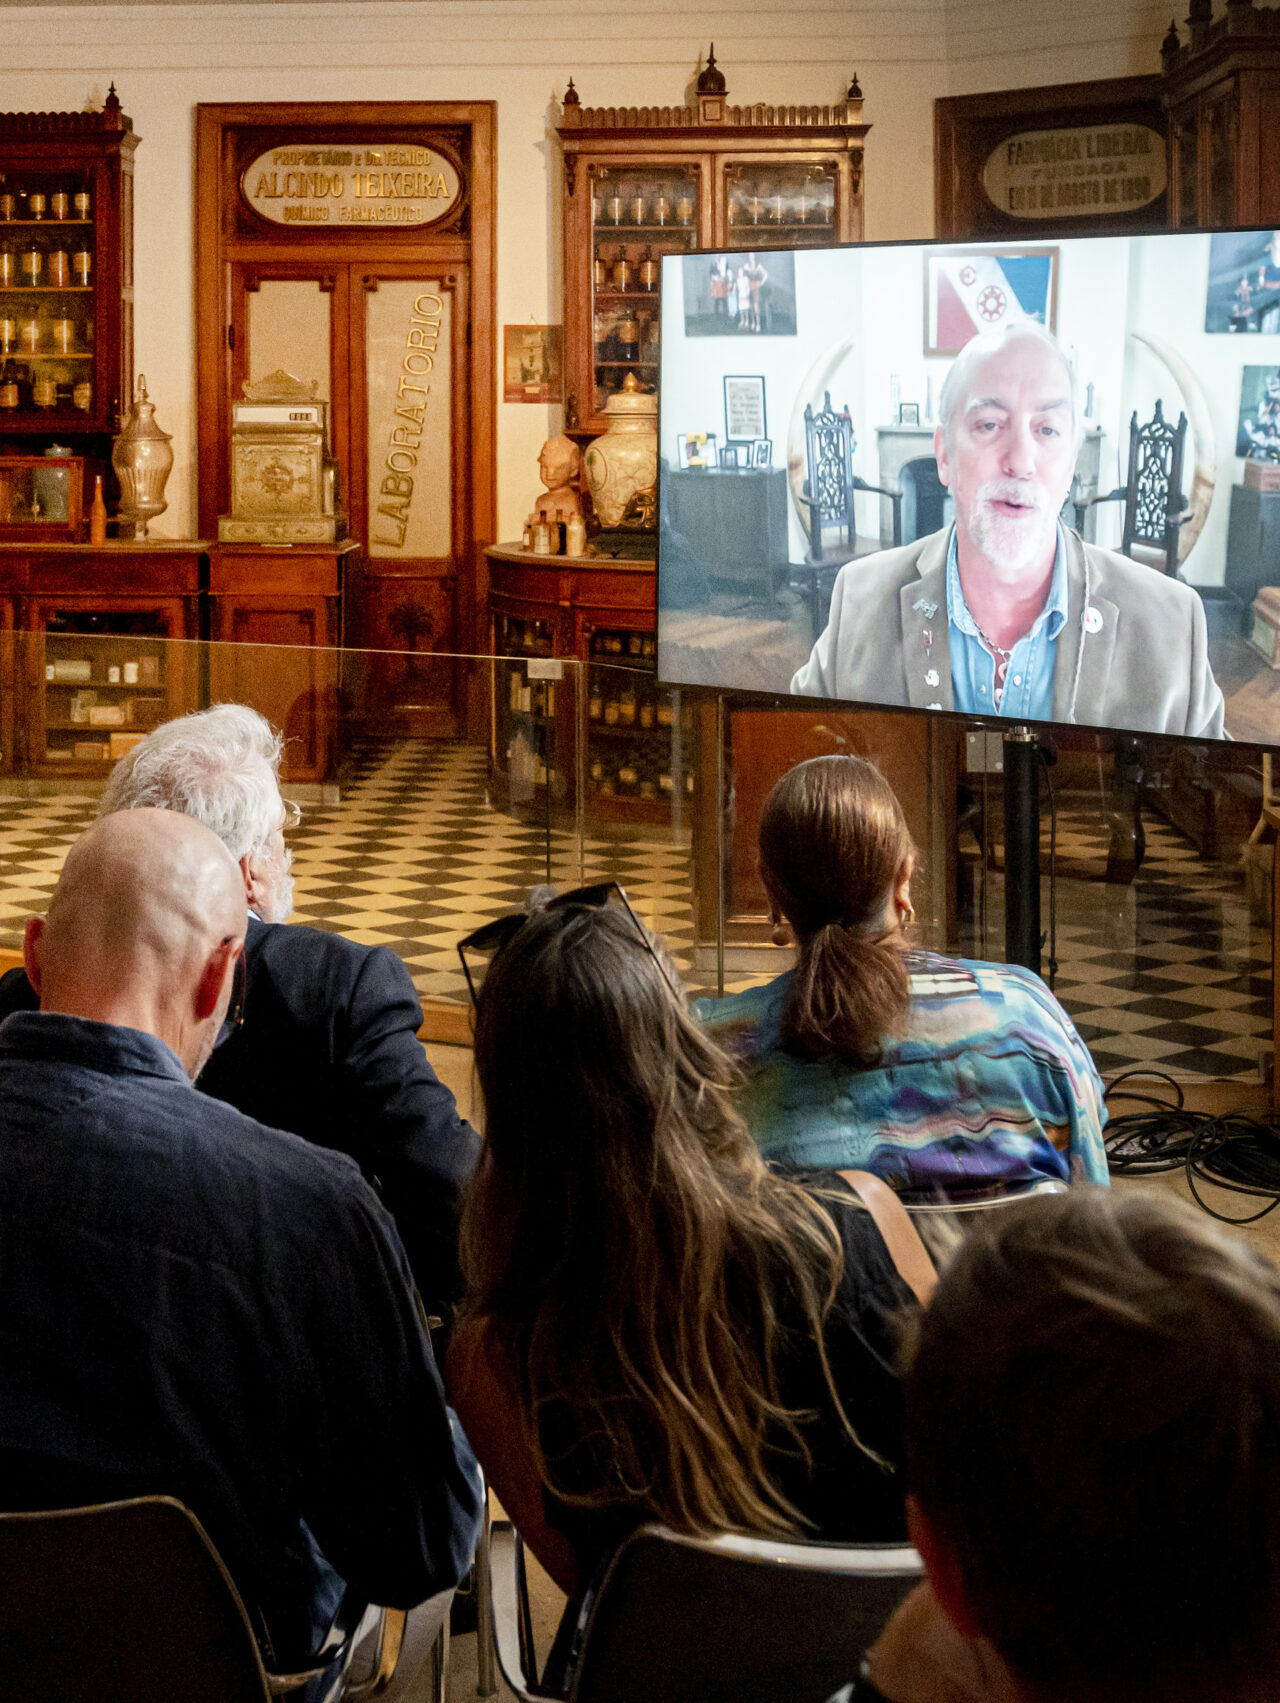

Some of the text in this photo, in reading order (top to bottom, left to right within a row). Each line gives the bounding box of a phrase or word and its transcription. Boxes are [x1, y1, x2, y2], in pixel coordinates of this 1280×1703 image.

[254, 171, 450, 198] ALCINDO TEIXEIRA
[372, 292, 445, 550] LABORATORIO
